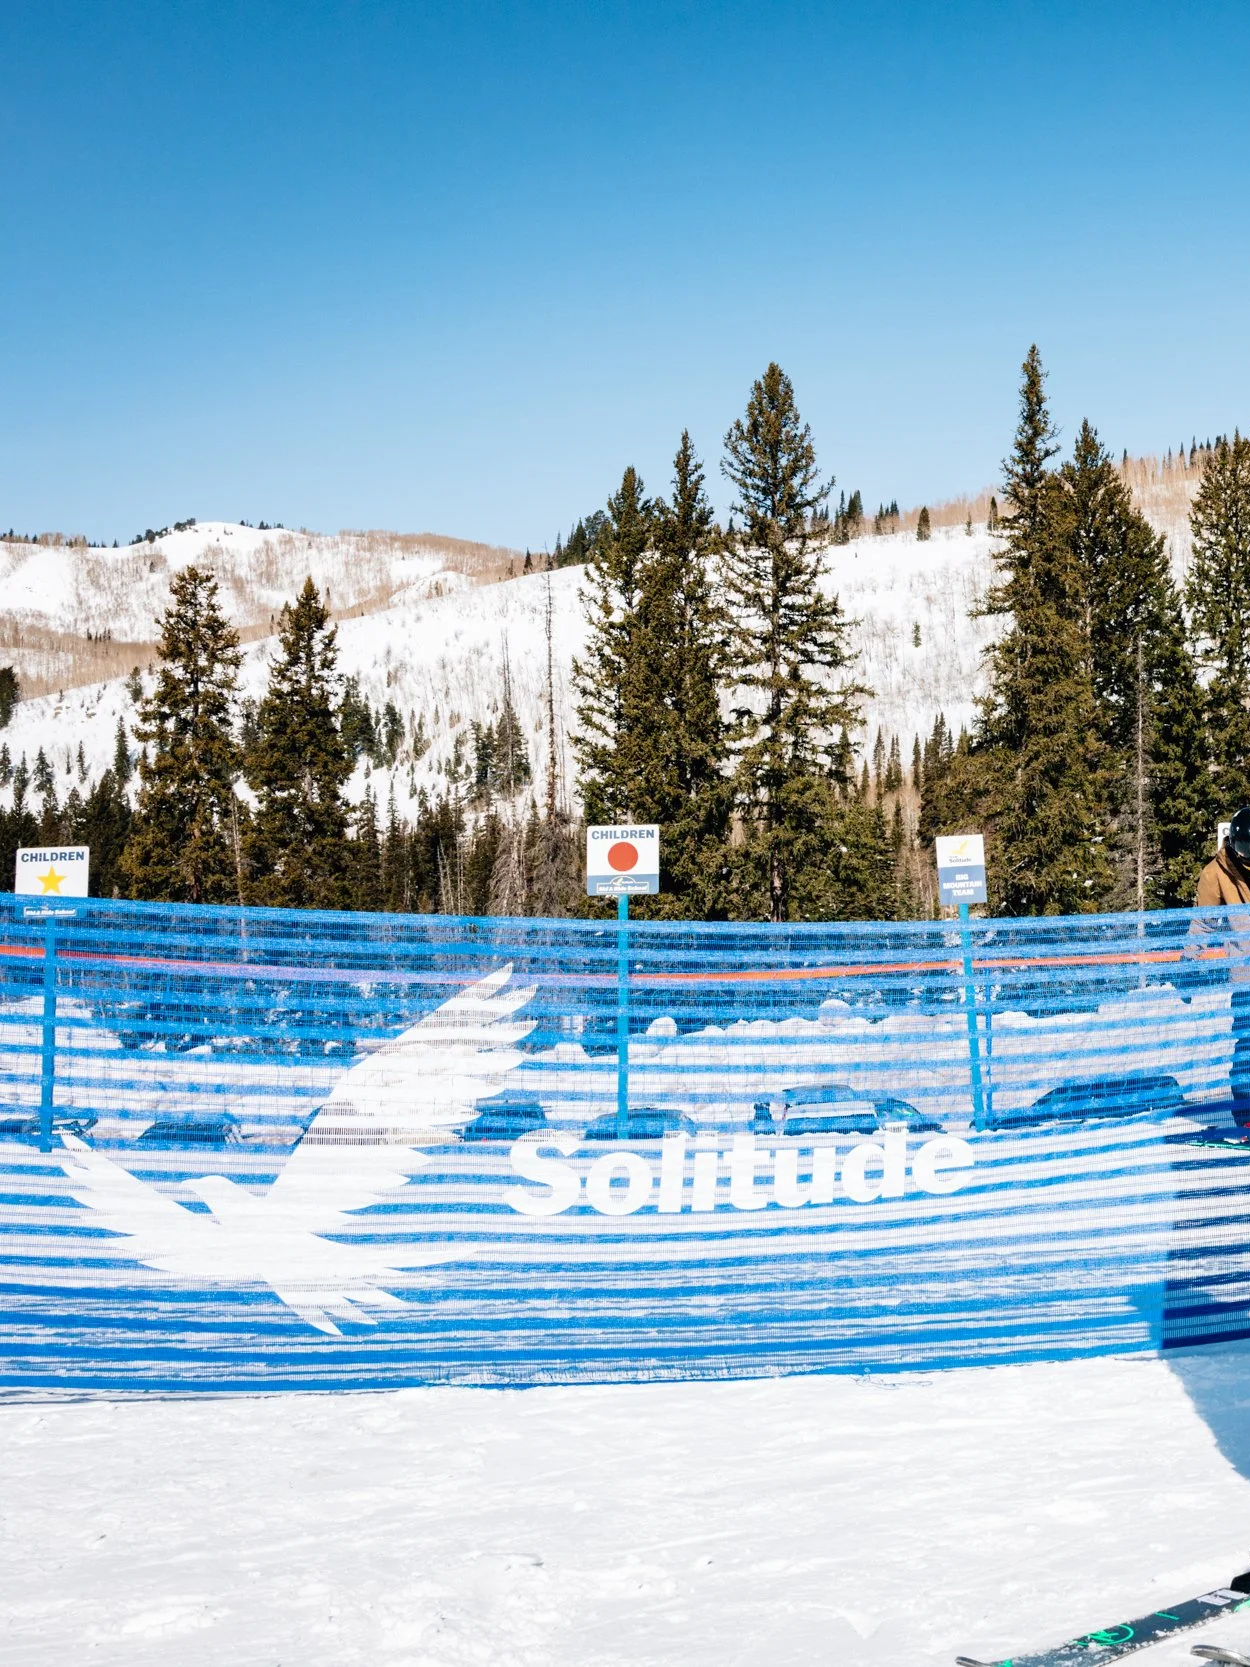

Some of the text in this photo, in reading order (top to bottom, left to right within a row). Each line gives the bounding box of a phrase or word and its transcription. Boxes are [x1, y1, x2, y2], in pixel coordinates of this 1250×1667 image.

[591, 829, 655, 840] CHILDREN
[21, 851, 84, 862] CHILDREN
[942, 880, 983, 890] MOUNTAIN
[952, 888, 974, 897] TEAM
[503, 1122, 975, 1215] Solitude
